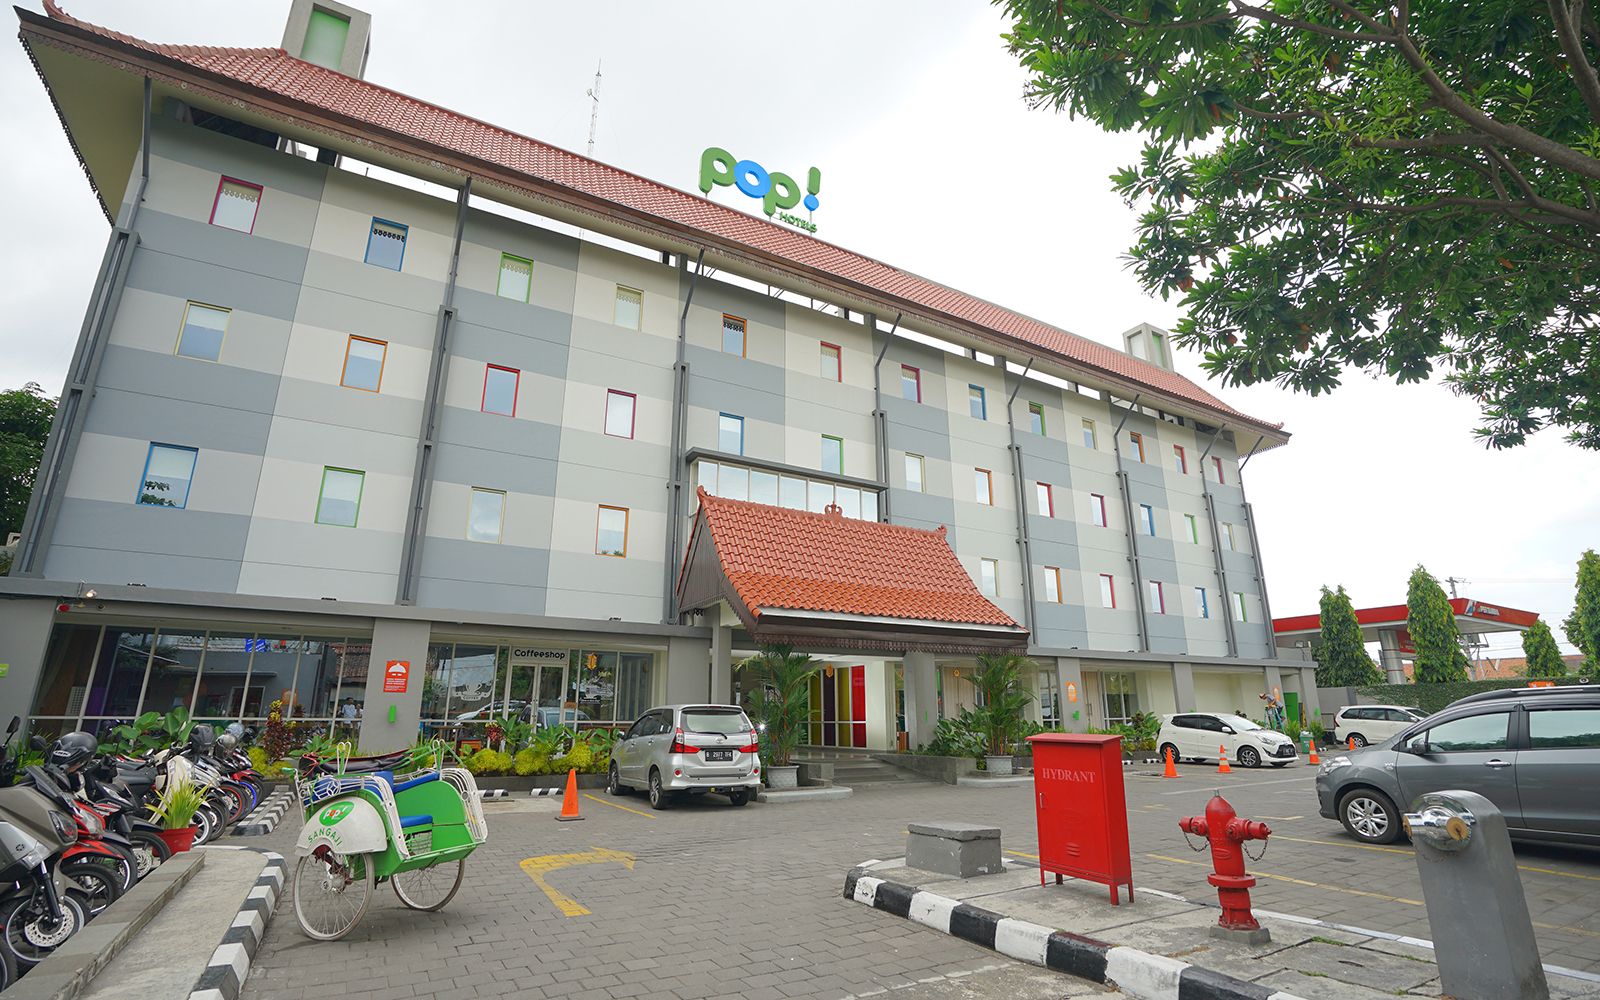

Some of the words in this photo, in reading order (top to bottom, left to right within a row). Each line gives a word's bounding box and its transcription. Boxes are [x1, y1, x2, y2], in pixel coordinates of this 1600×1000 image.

[514, 648, 566, 660] Coffeeshop
[1042, 767, 1096, 783] HYDRANT
[308, 827, 342, 846] SANGAJI
